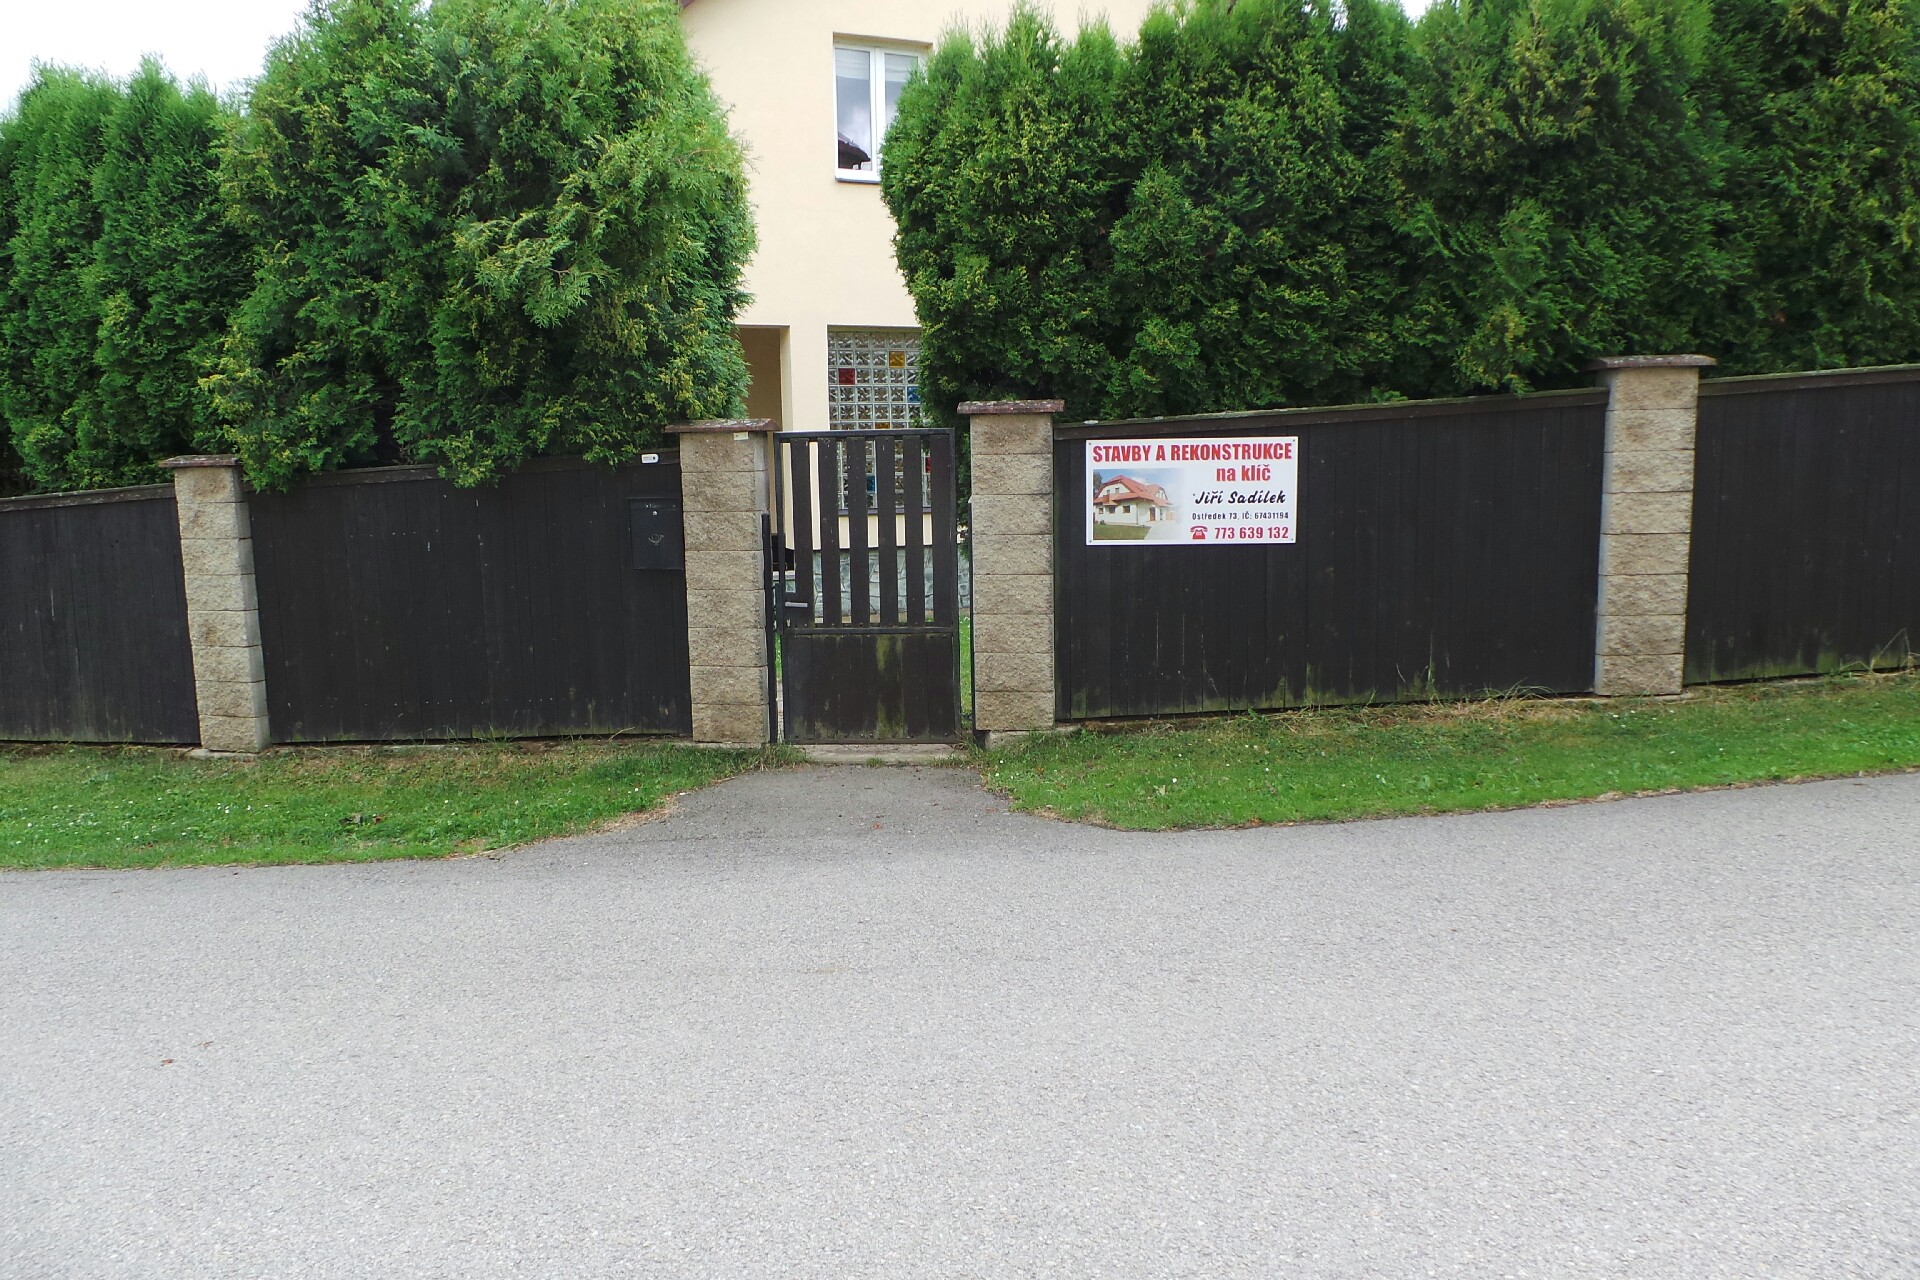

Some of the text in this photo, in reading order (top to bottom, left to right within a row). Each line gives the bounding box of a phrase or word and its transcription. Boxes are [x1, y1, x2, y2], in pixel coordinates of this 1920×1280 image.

[1093, 443, 1292, 462] STAVBY A REKONSTRUKCE
[1216, 464, 1271, 481] na klíč
[1195, 491, 1286, 504] Jiří Sadílek
[1192, 512, 1226, 520] Ostředek
[1215, 527, 1289, 539] 773 639 132
